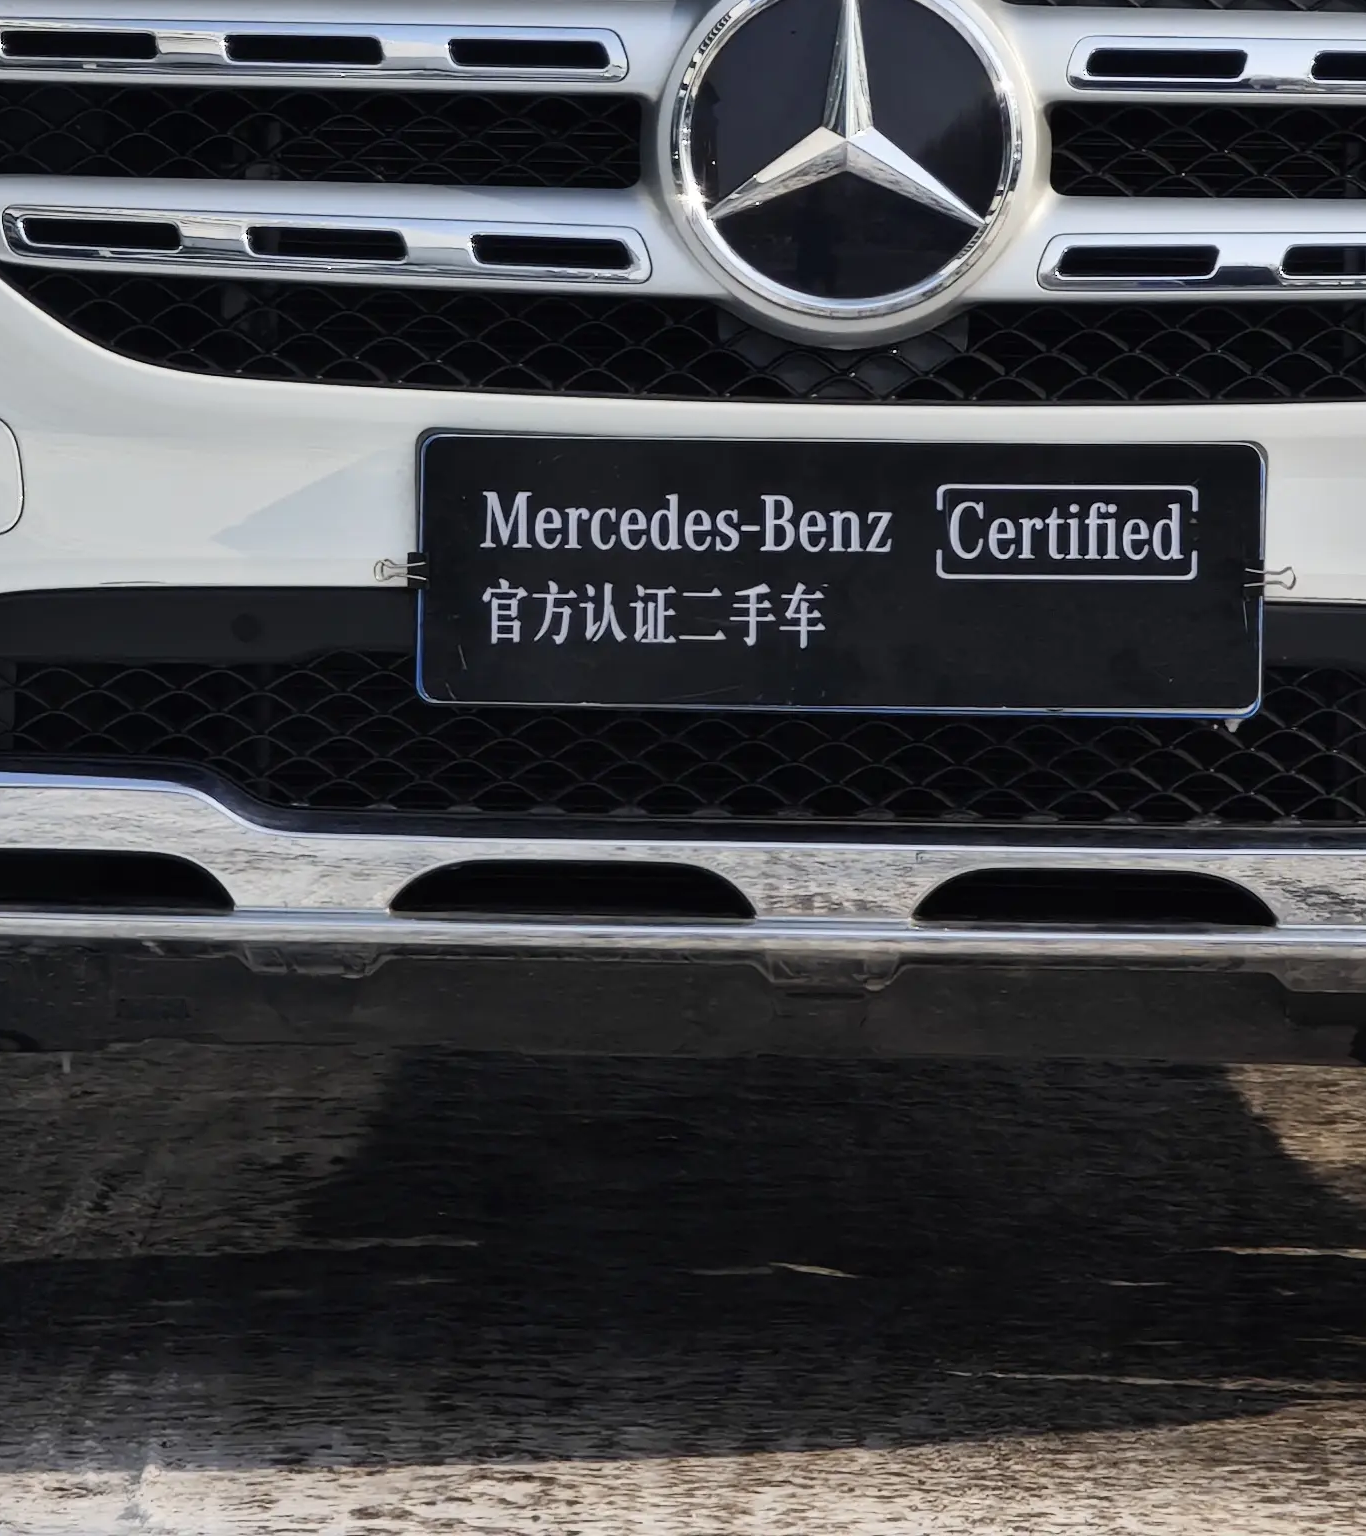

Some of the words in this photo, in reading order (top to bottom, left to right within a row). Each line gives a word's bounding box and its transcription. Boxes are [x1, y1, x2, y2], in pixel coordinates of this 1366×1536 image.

[480, 491, 893, 552] Mercedes-Benz
[949, 501, 1184, 561] Certified
[482, 578, 827, 649] 官方认证二手车
